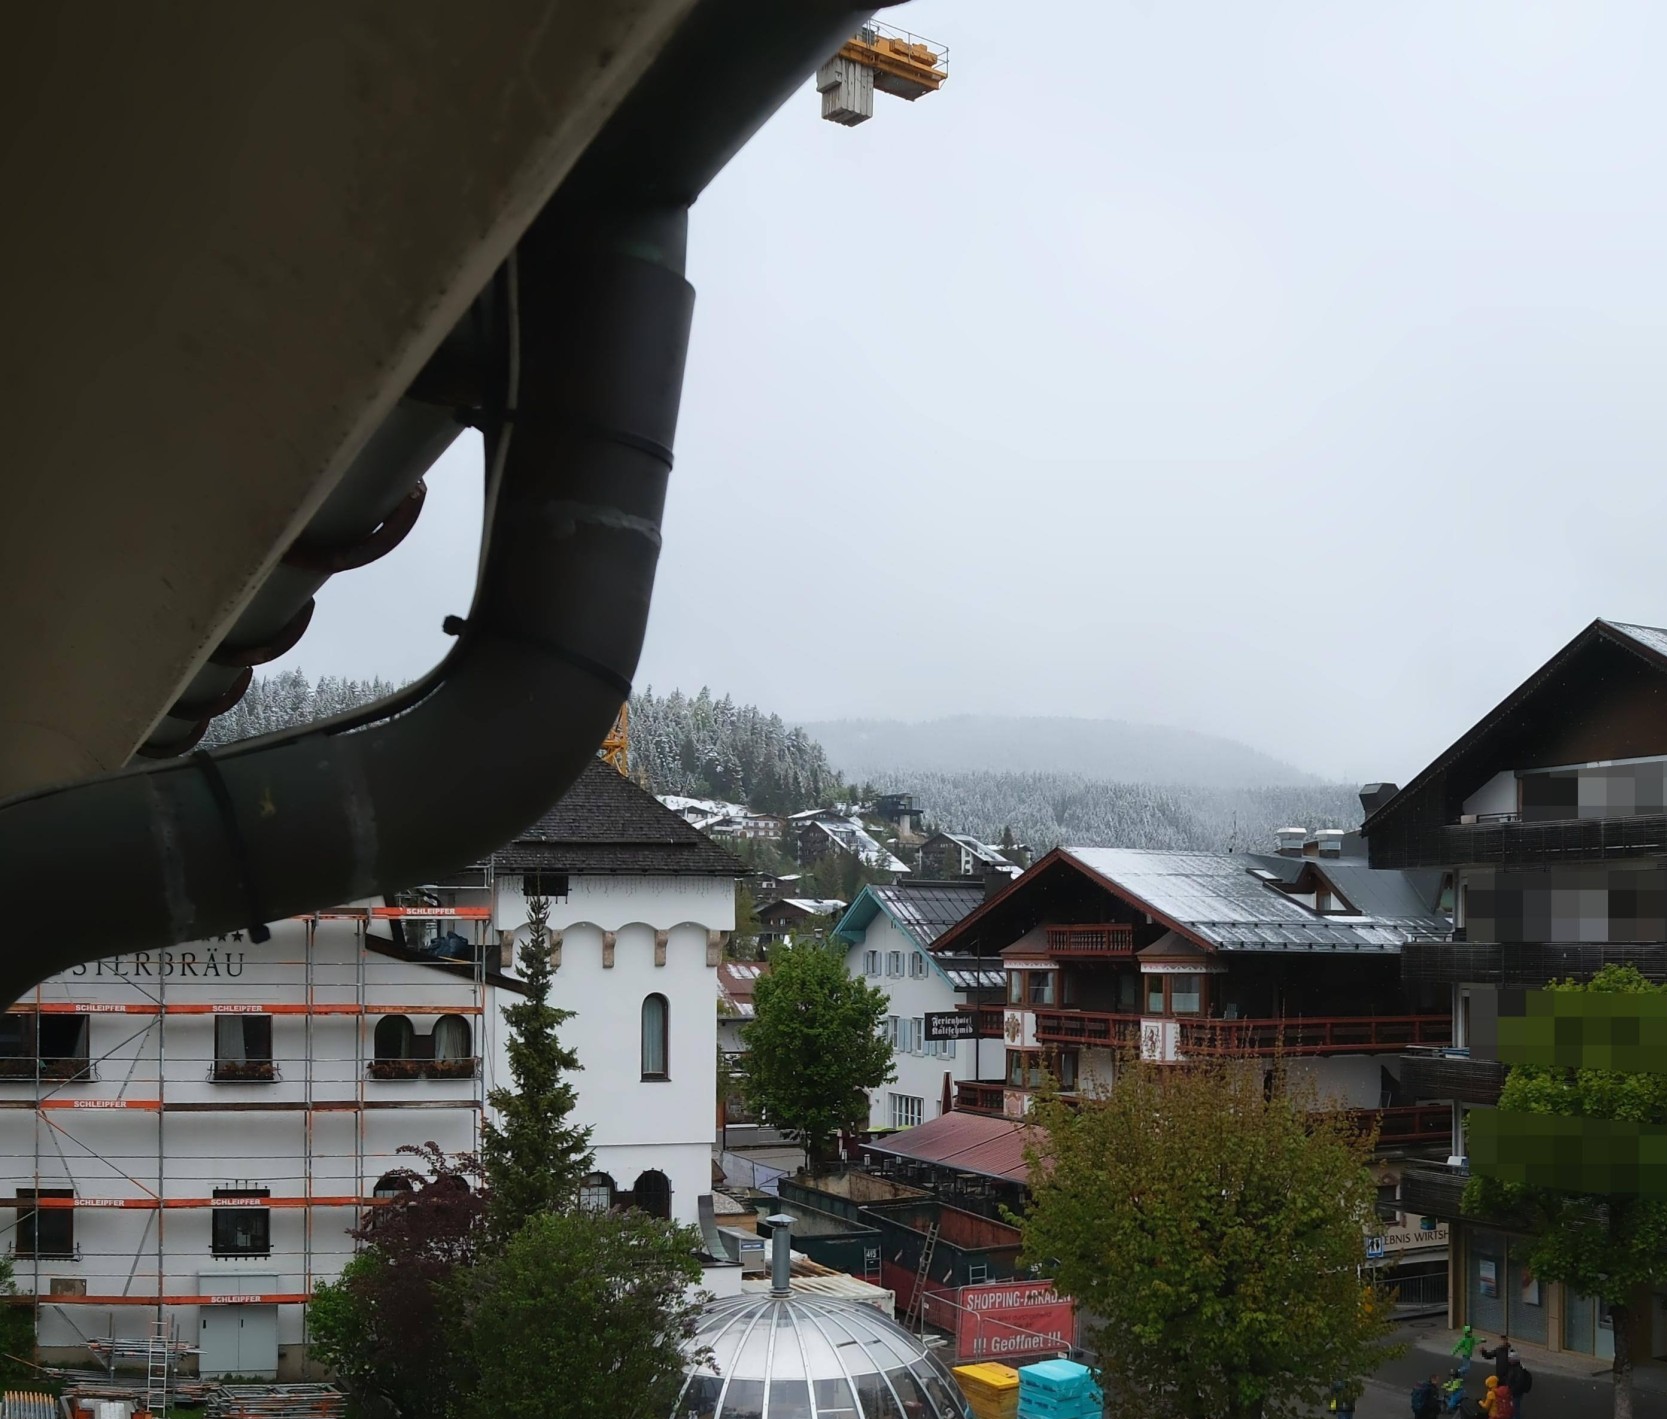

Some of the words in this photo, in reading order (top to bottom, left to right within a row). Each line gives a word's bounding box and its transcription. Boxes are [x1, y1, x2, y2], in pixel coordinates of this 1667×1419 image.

[406, 907, 456, 915] SCHLEIPFER
[75, 1004, 126, 1012] SCHLEIPFER
[212, 1005, 263, 1013] SCHLEIPFER
[210, 1198, 261, 1206] SCHLEIPFER
[211, 1295, 261, 1303] SCHLEIPFER
[991, 1333, 1044, 1352] Geöffnet
